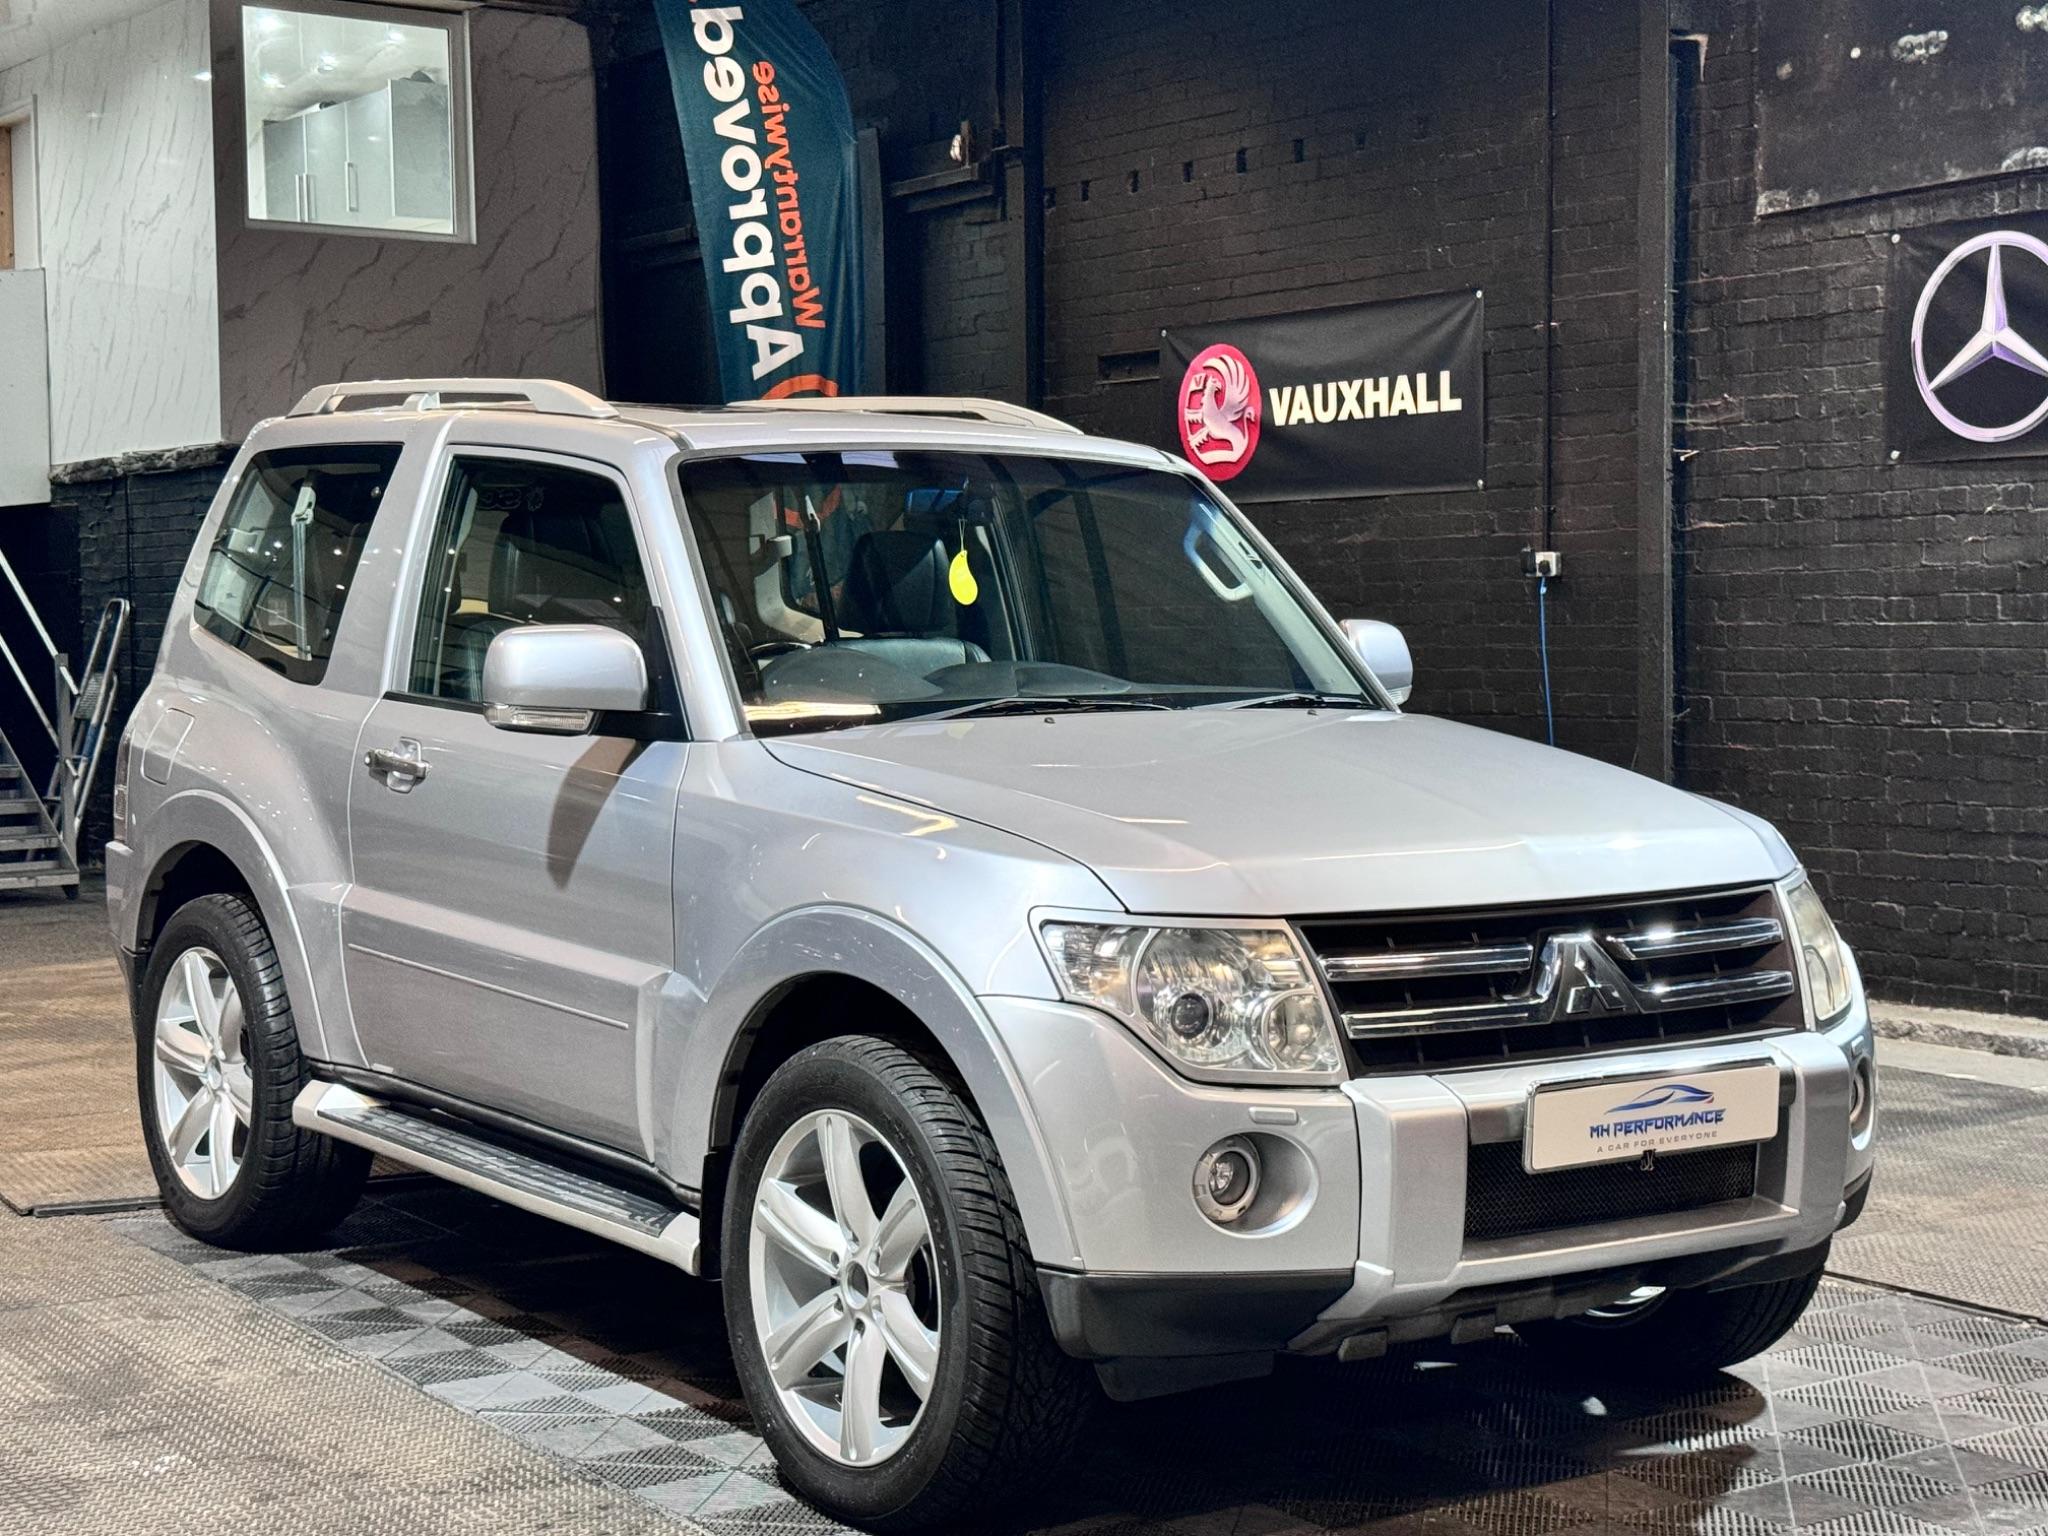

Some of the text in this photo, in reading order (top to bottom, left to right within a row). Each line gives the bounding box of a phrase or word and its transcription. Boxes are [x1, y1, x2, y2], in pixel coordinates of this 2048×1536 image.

[1269, 370, 1462, 426] VAUXHALL
[1589, 1109, 1726, 1139] MH PERFORMANCE
[1608, 1143, 1629, 1152] CAR
[1633, 1138, 1656, 1149] FOR
[1659, 1131, 1718, 1144] EVERYONE
